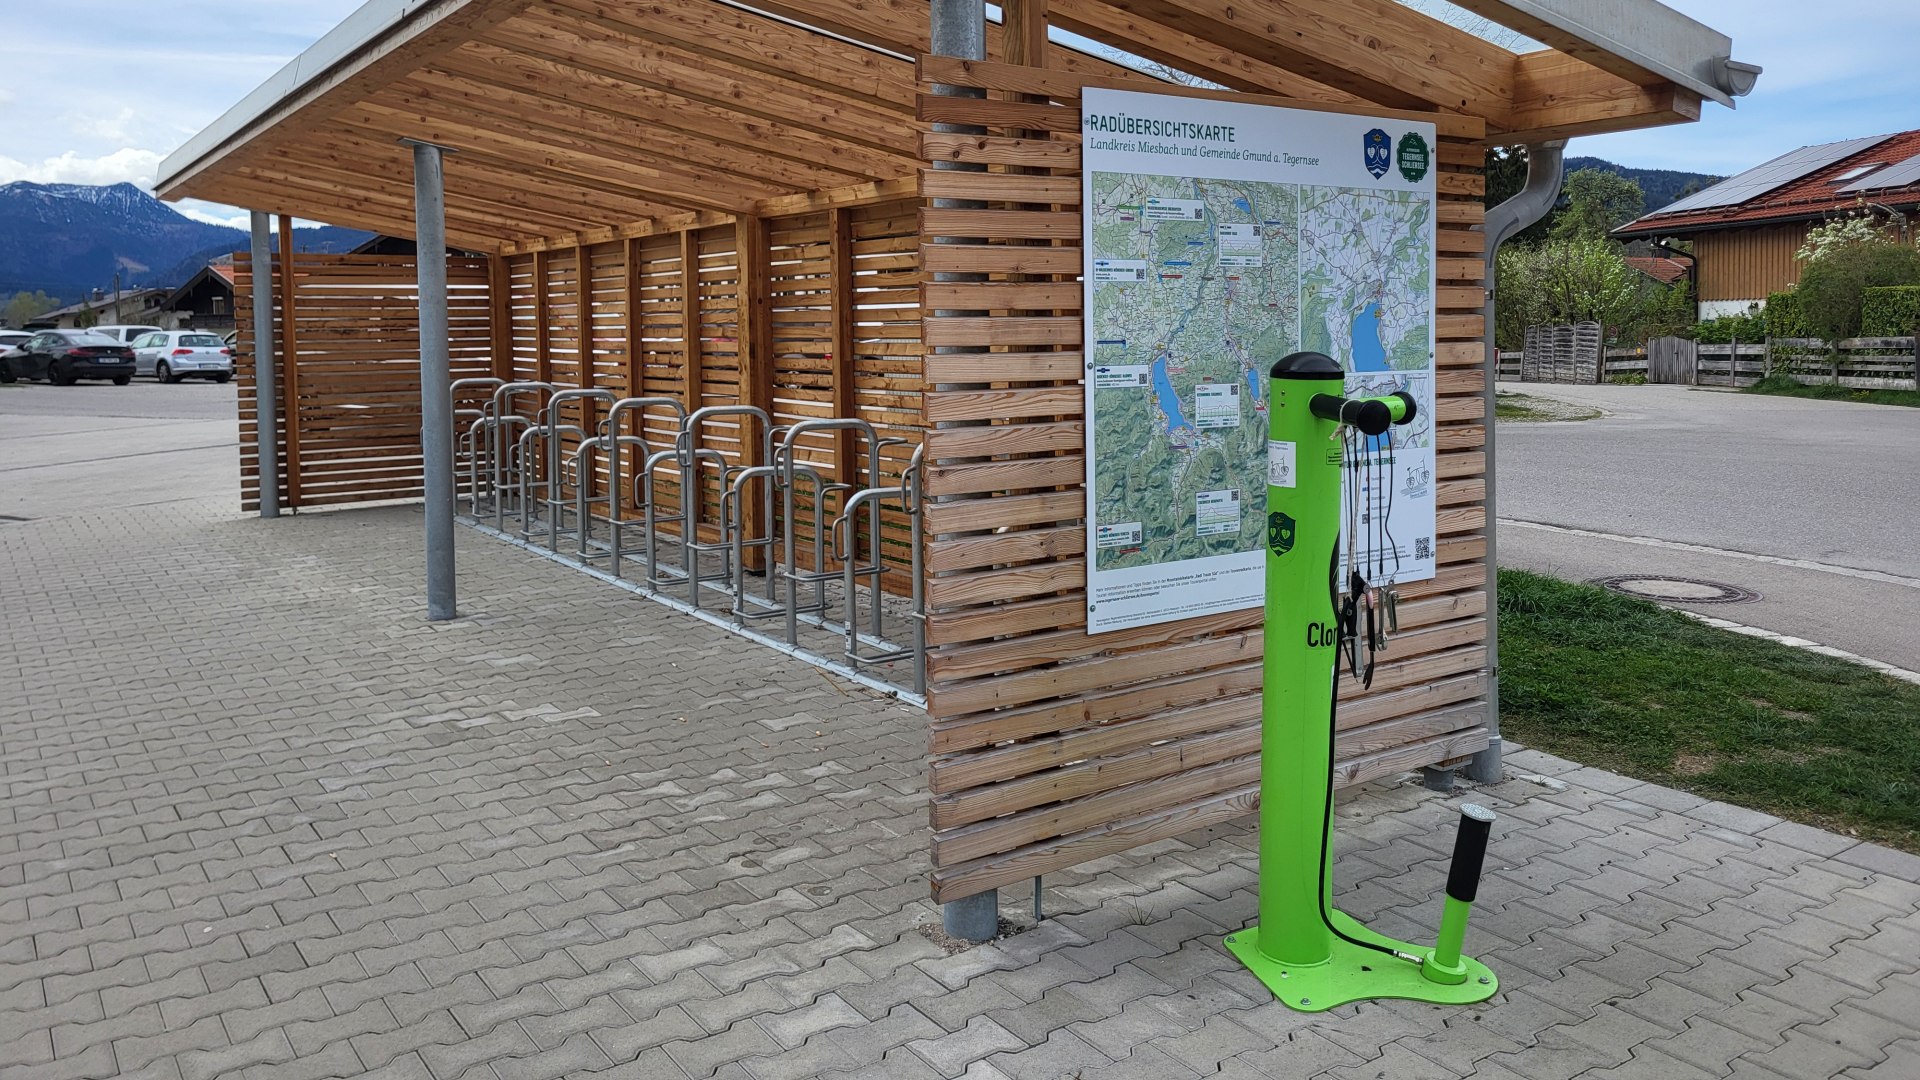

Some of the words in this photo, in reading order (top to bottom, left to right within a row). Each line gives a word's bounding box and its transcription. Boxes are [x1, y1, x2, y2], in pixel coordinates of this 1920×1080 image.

[1090, 113, 1235, 142] RADÜBERSICHTSKARTE
[1089, 137, 1136, 152] Landkreis
[1138, 140, 1179, 155] Miesbach
[1181, 145, 1198, 157] und
[1199, 146, 1241, 160] Gemeinde
[1242, 149, 1272, 163] Gmund
[1273, 155, 1281, 164] a.
[1282, 153, 1320, 167] Tegernsee
[1402, 153, 1424, 161] TEGERNSEE
[1402, 161, 1424, 169] SCHLIERSEE
